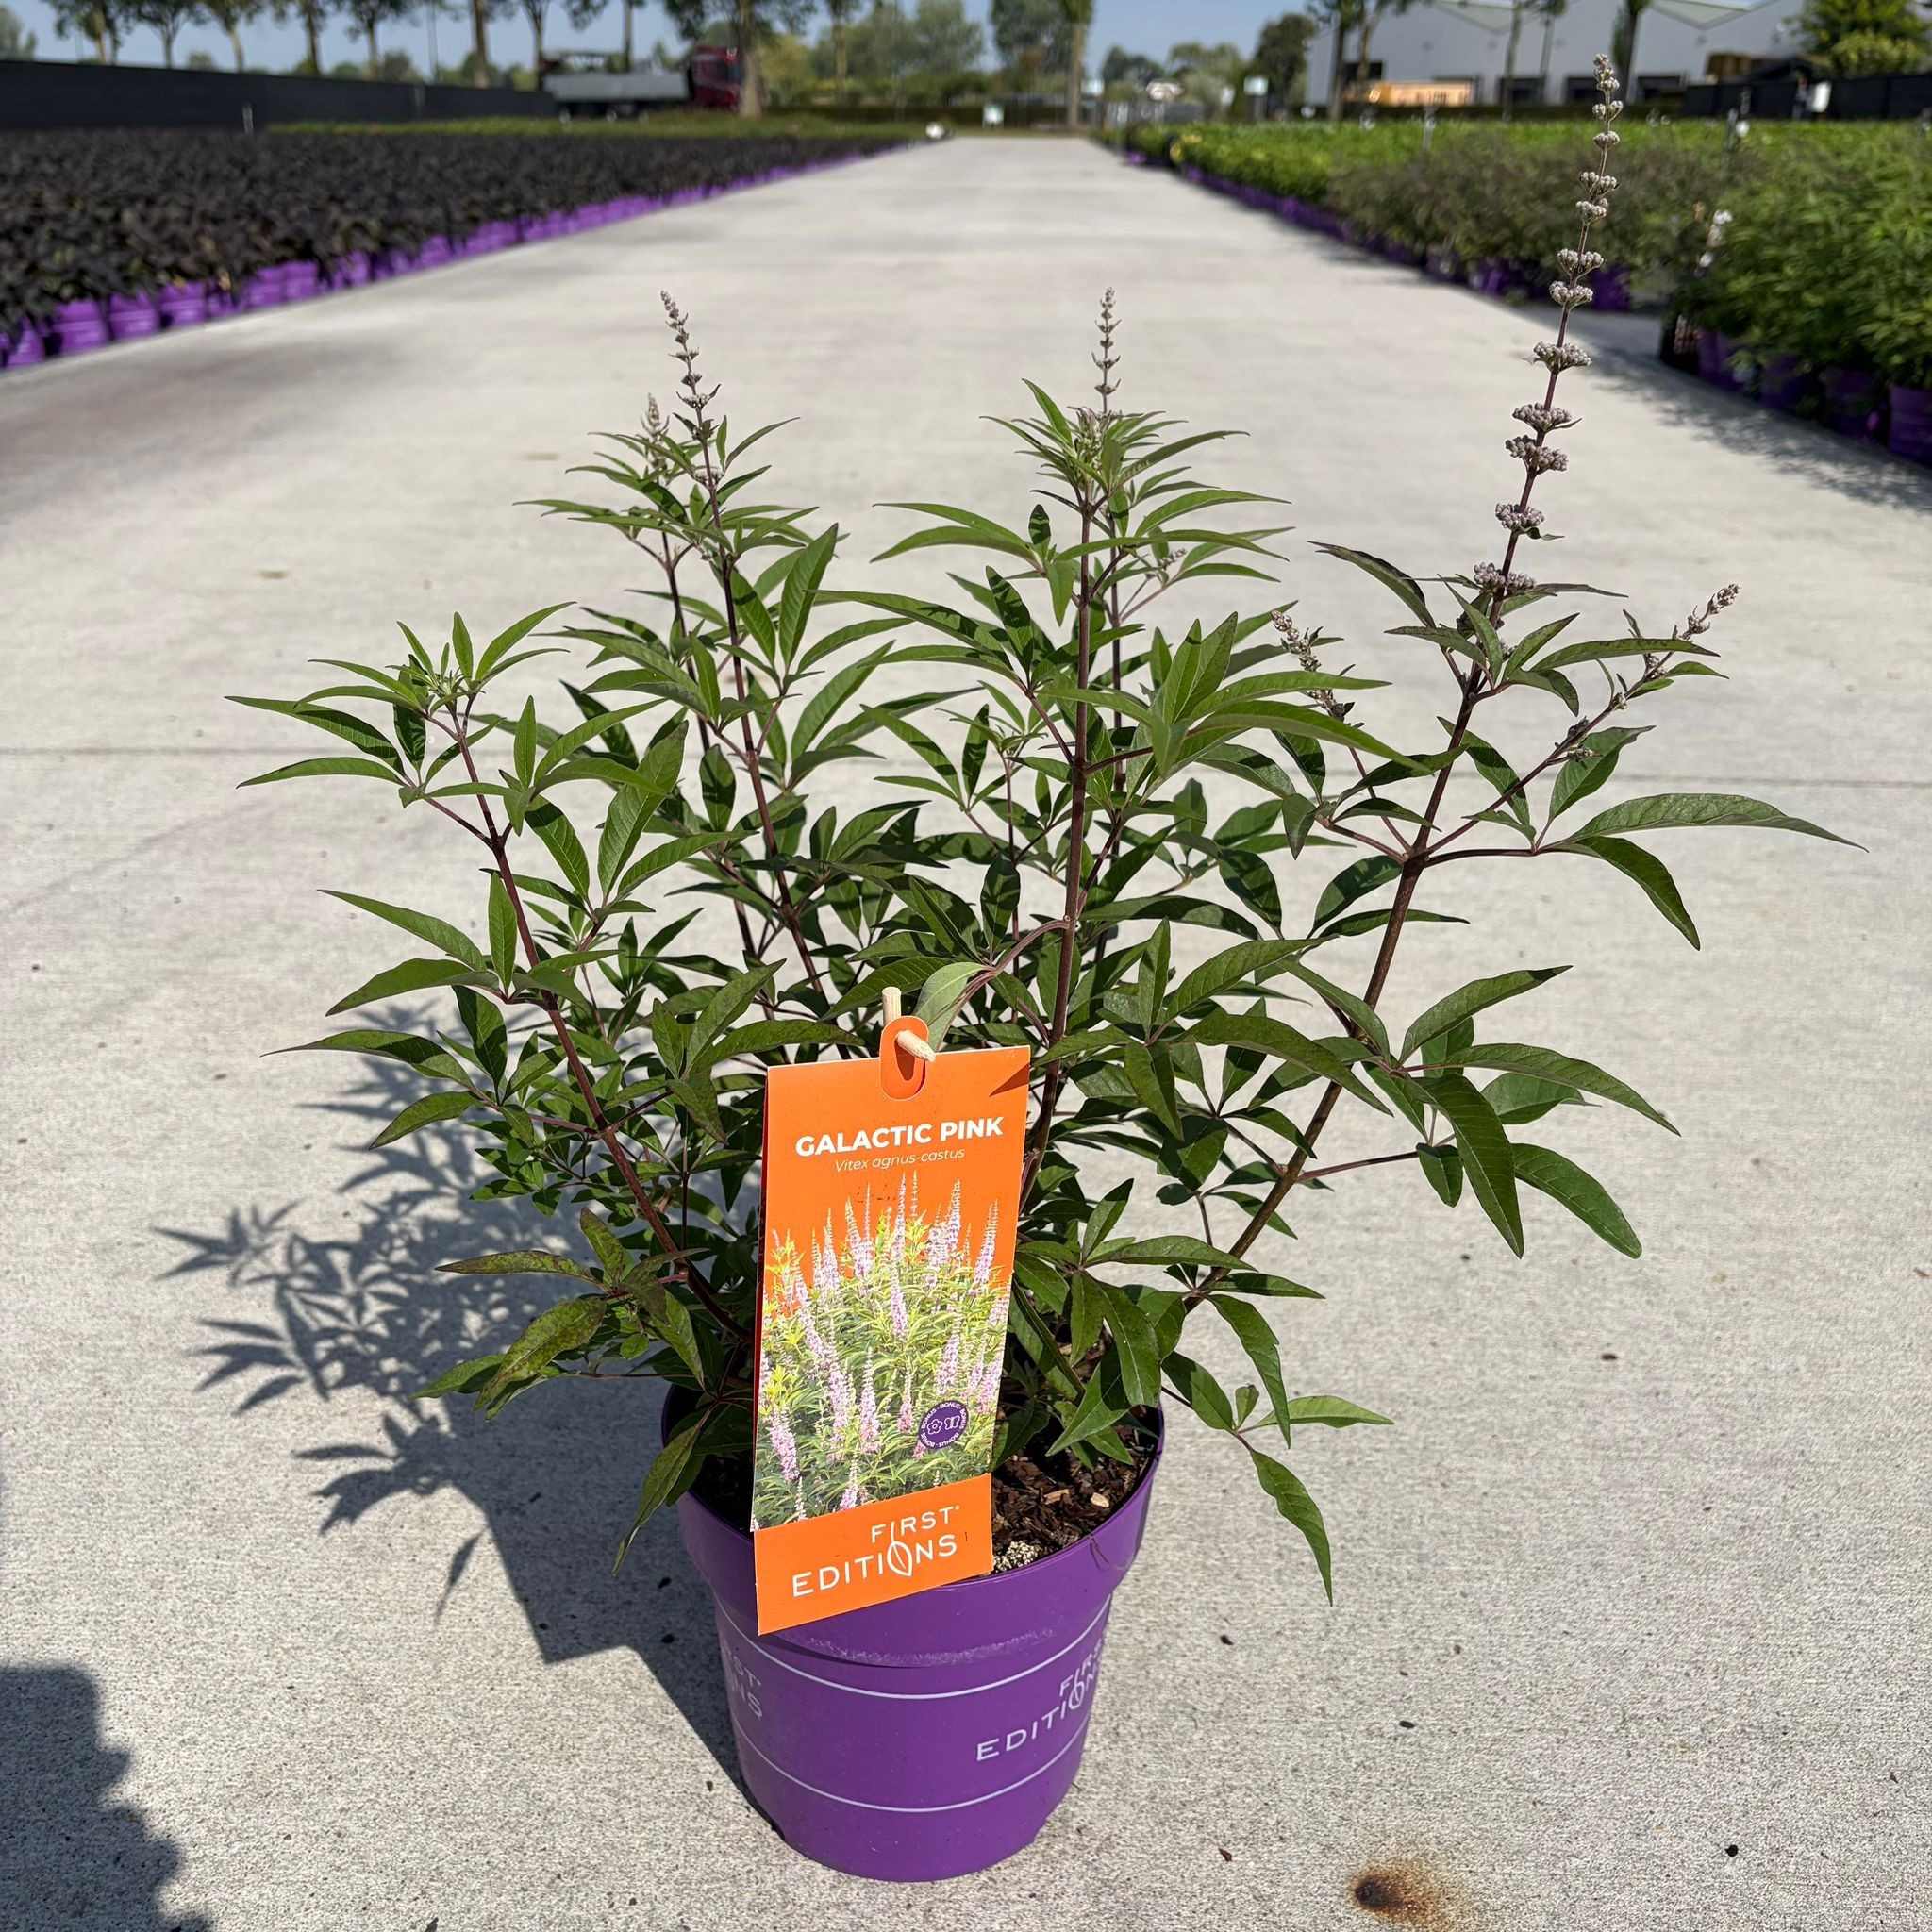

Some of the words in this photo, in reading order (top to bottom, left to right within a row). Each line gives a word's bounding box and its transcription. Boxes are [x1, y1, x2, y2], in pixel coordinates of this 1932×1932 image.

[795, 1124, 933, 1158] GALACTIC
[940, 1116, 1005, 1141] PINK
[835, 1158, 869, 1173] Vitex
[872, 1148, 966, 1170] agnus-castus
[791, 1534, 958, 1598] EDITIONS
[976, 1662, 1097, 1762] EDITION
